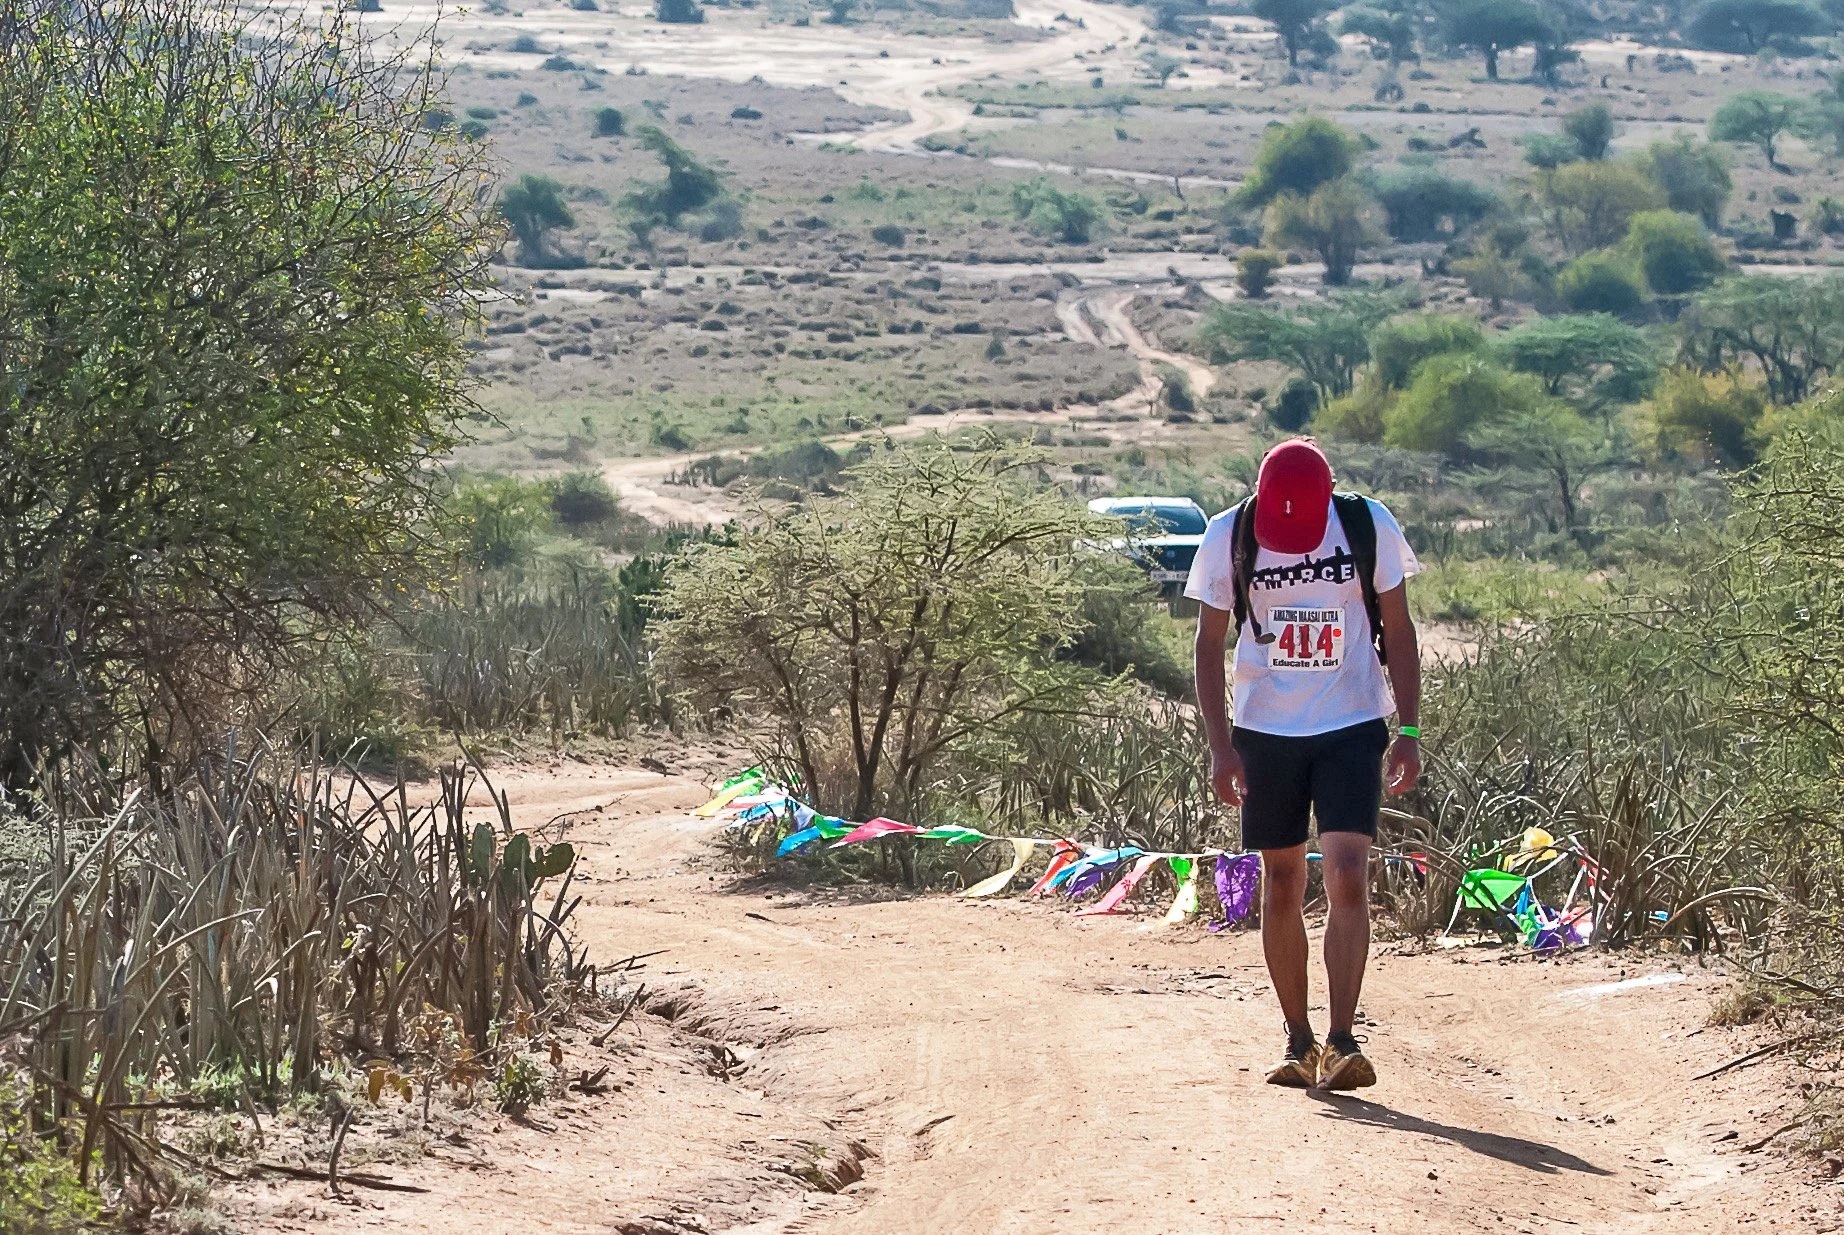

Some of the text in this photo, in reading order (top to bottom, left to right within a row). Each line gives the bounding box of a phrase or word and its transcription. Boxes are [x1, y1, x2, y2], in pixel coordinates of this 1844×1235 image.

[1274, 610, 1338, 622] AMAZING MAASAI ULTRA
[1279, 624, 1333, 658] 414
[1273, 659, 1310, 667] Educate
[1322, 659, 1338, 667] Girl
